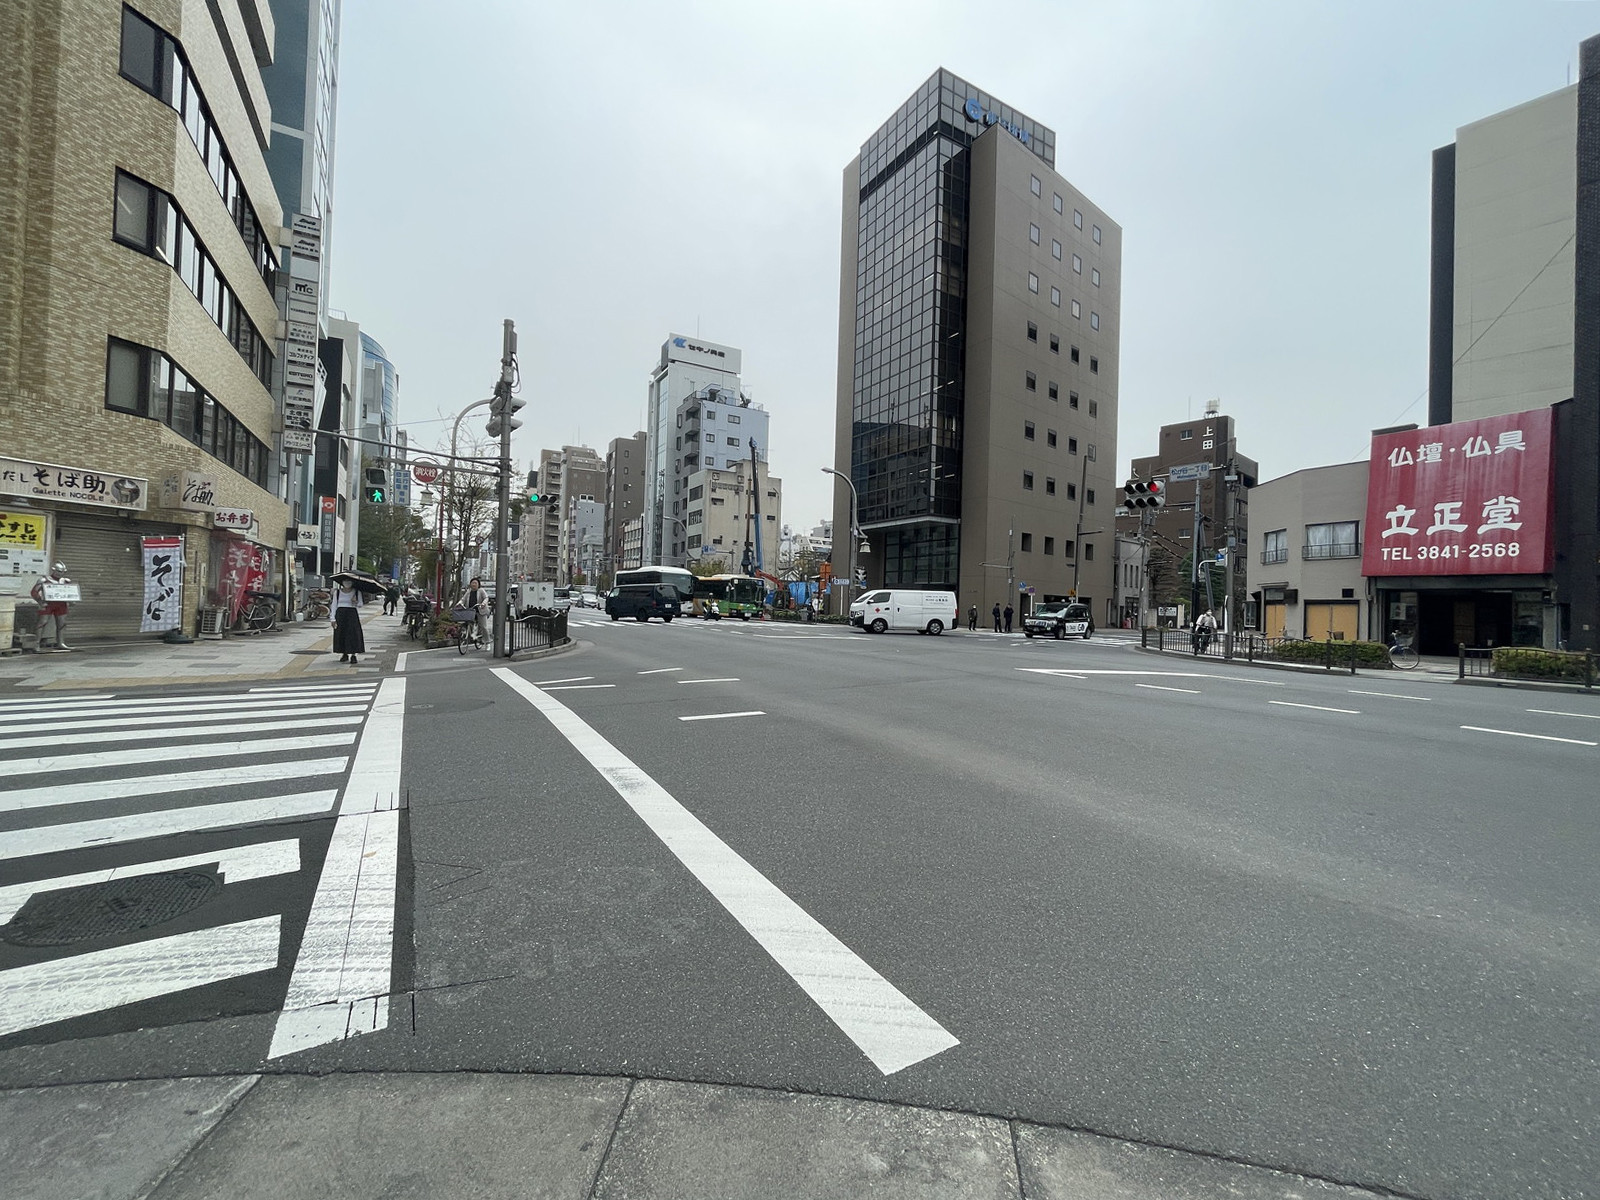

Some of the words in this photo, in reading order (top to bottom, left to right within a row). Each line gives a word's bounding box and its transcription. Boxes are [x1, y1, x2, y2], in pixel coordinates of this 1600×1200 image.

[1203, 426, 1213, 450] 上田
[1387, 430, 1526, 468] 仏壇・仏具
[3, 471, 28, 483] だし
[33, 466, 106, 494] そば助
[415, 466, 436, 477] 消火栓
[32, 487, 66, 498] Galette
[215, 512, 249, 525] お弁当
[1381, 495, 1523, 539] 立正堂
[1381, 547, 1412, 561] TEL
[1417, 542, 1520, 560] 3841-2568
[146, 553, 175, 621] そば
